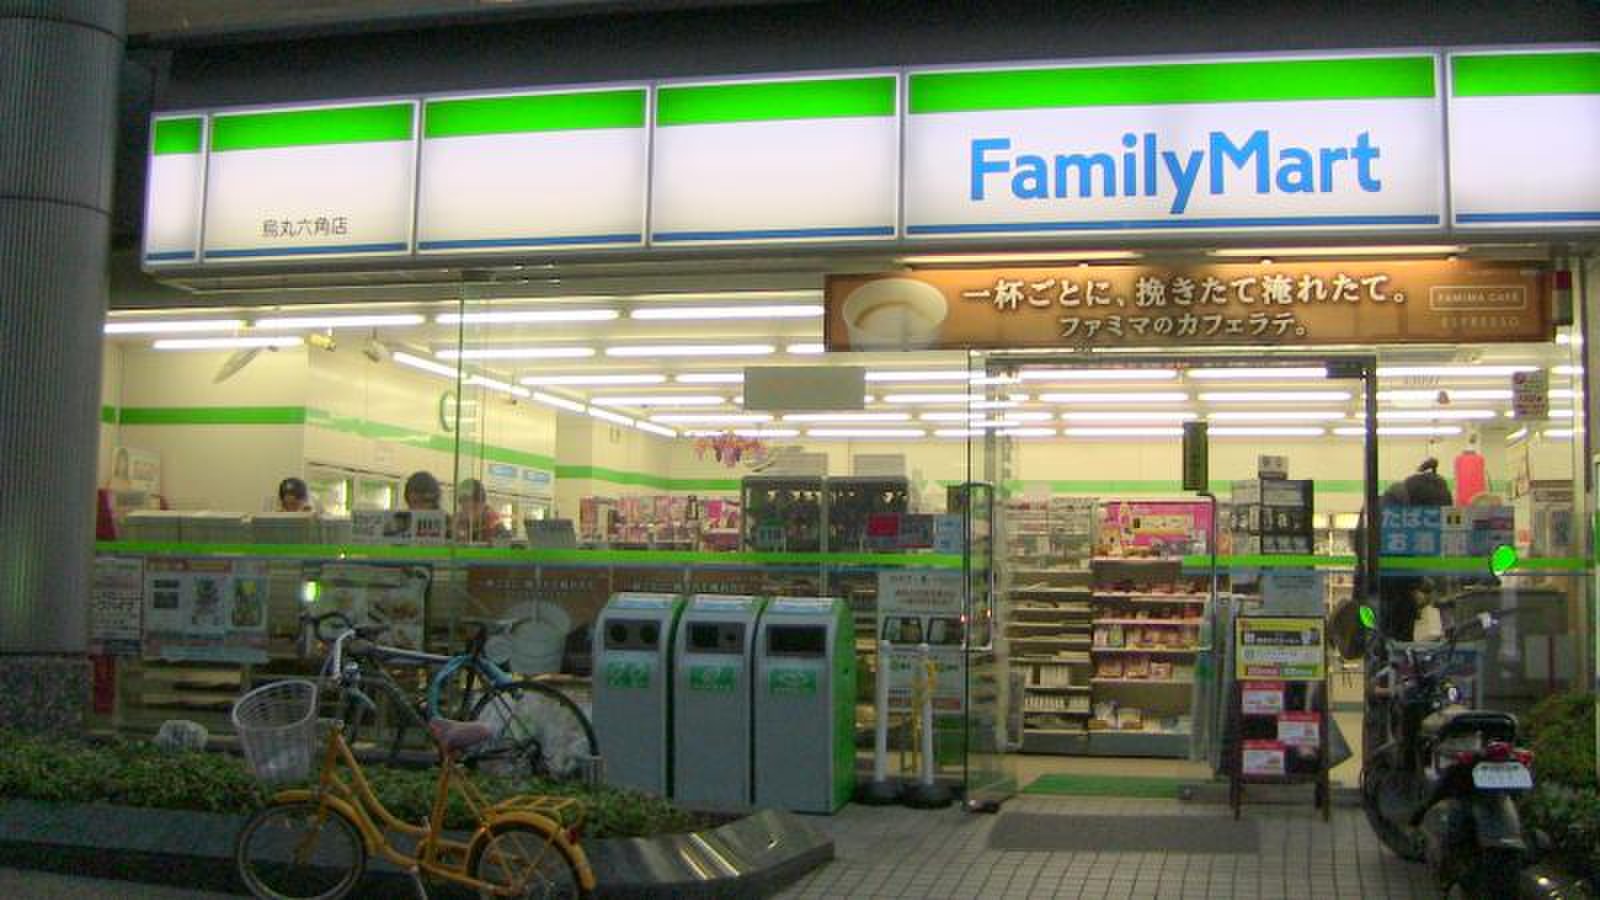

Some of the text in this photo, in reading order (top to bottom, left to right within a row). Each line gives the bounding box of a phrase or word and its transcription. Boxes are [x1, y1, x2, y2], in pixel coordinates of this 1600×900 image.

[970, 130, 1382, 214] FamilyMart
[1059, 312, 1308, 338] ファミマのカフェラテ。
